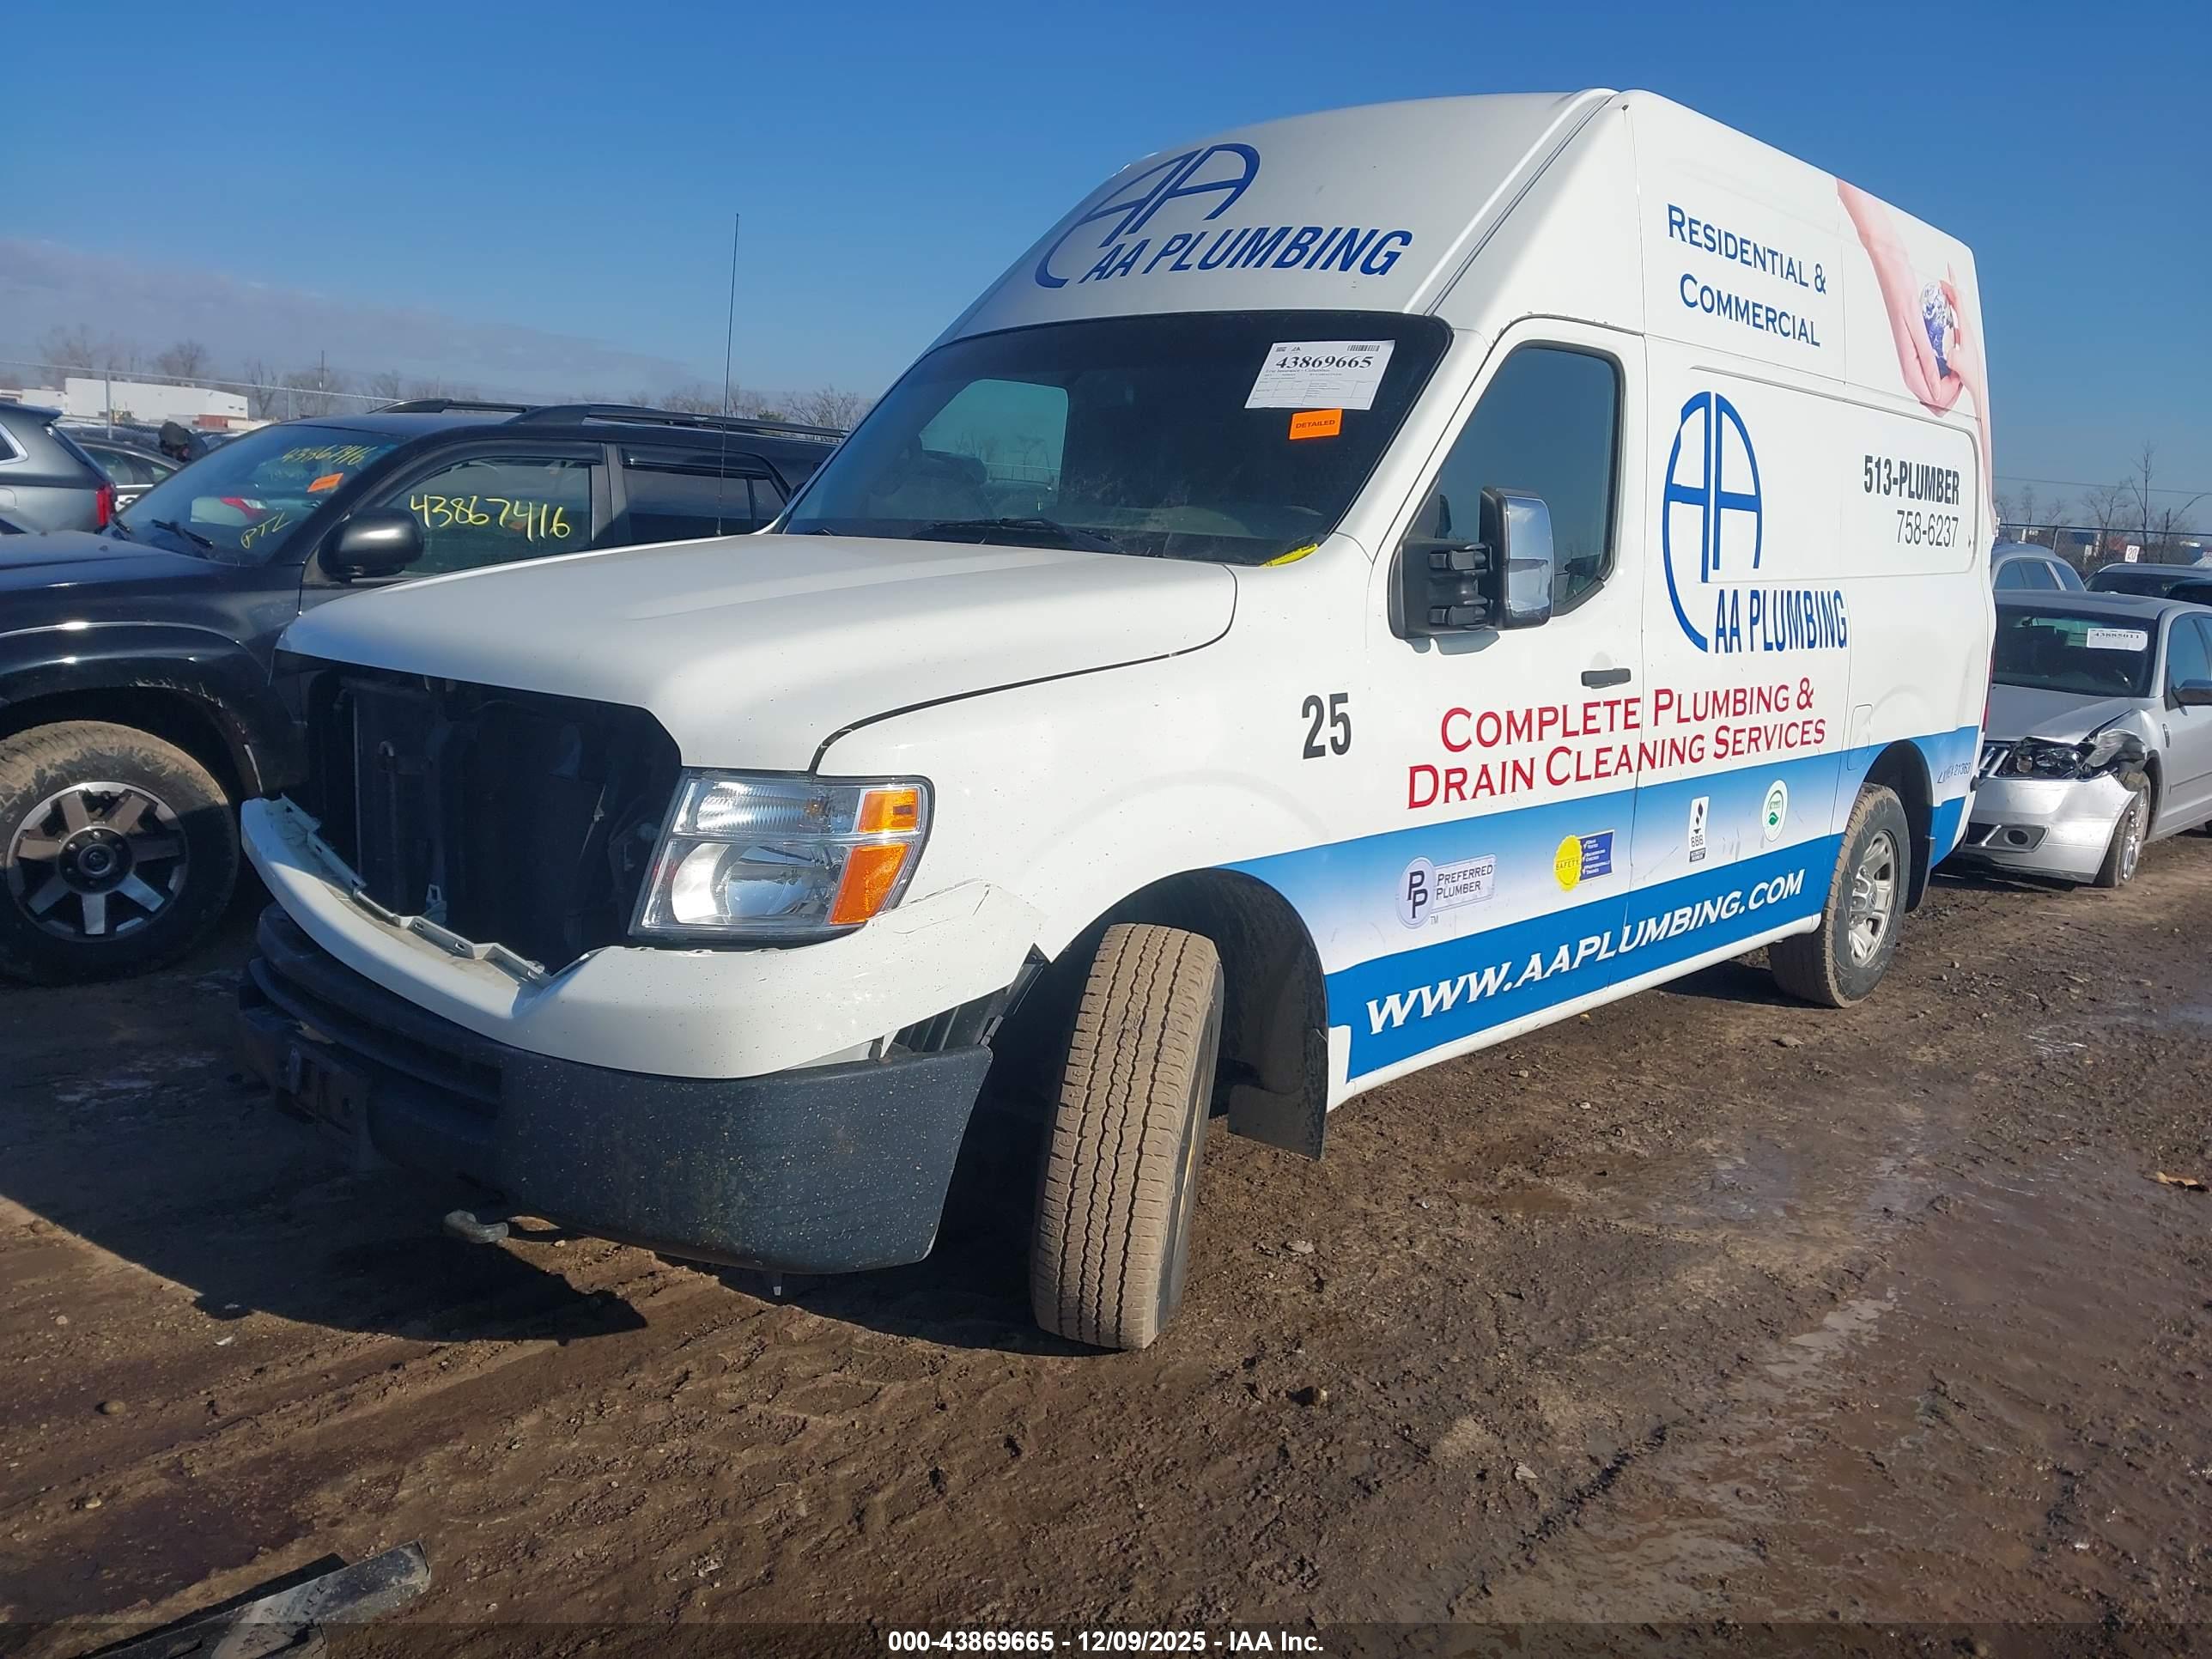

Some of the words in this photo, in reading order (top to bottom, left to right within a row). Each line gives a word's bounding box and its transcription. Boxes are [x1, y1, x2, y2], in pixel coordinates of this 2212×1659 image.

[1077, 238, 1152, 284] AA
[1141, 226, 1413, 276] PLUMBING
[1814, 263, 1826, 295] &
[1275, 356, 1374, 368] 43869665
[1295, 419, 1336, 429] DETAILED
[1864, 454, 1960, 506] 513-PLUMBER
[410, 494, 570, 543] 43867416
[1896, 509, 1959, 549] 758-6237
[2127, 547, 2136, 561] 20
[1715, 588, 1742, 653] AA
[1749, 588, 1847, 653] PLUMBING
[1796, 677, 1814, 710] &
[1301, 692, 1352, 759] 25
[1555, 859, 1579, 871] SAFETY
[1365, 868, 1807, 1035] WWW.AAPLUMBING.COM
